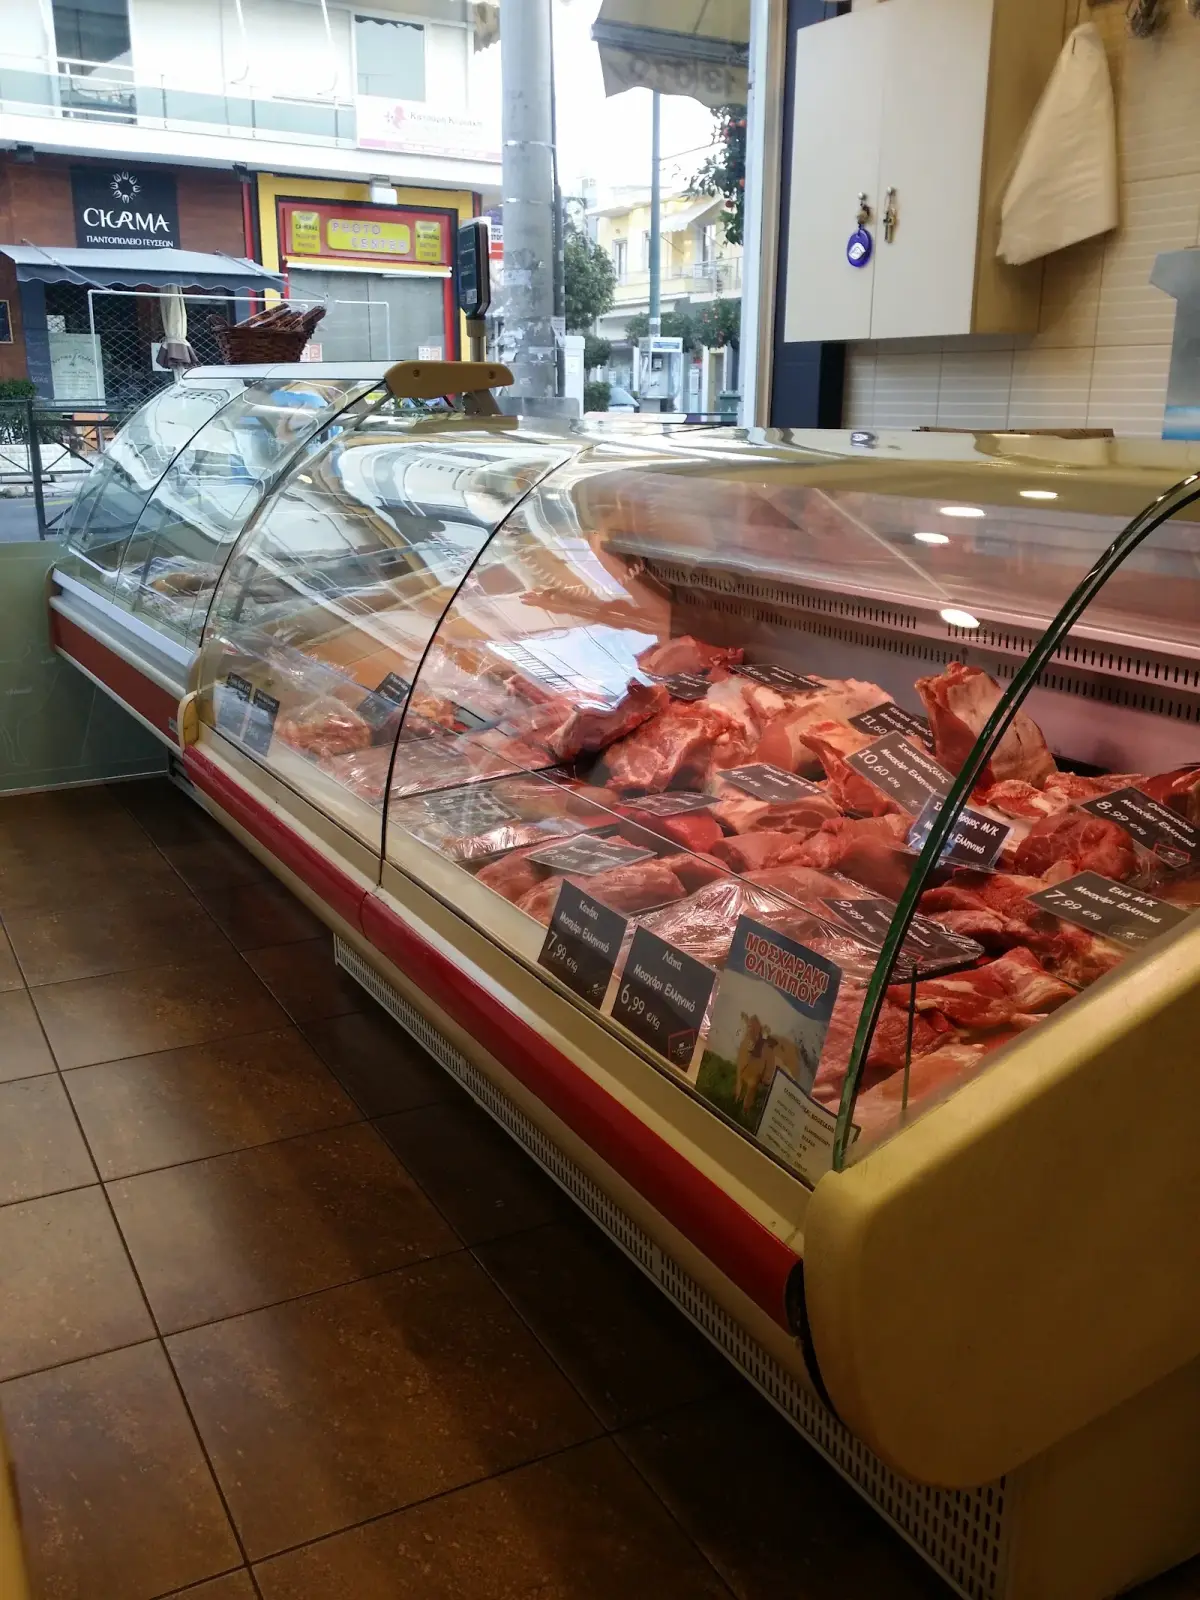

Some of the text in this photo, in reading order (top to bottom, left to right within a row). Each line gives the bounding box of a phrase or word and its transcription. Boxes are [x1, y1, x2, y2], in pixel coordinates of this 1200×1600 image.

[331, 222, 382, 235] PHOTO
[86, 235, 174, 248] ΠΑΝΤΟΠΩΛΕΙΟ ΓΕΥΣΕΩΝ
[351, 237, 408, 251] CENTER
[860, 715, 887, 734] 11,60
[858, 749, 889, 776] 10,60
[880, 748, 938, 795] Μοσχάρι Ελληνικό
[1096, 801, 1129, 822] 8,99
[1120, 799, 1197, 848] Μοσχάρι Ελληνικό
[954, 833, 985, 855] Ελληνικό
[1044, 889, 1082, 910] 7,99
[1074, 885, 1161, 924] Μοσχάρι Ελληνικό
[1108, 886, 1132, 899] Ελιά
[834, 900, 865, 921] 9,99
[559, 910, 610, 954] Μοσχάρι Ελληνικό
[547, 931, 567, 961] 7,99
[662, 950, 683, 972] Λάπα
[744, 931, 830, 994] ΜΟΣΧΑΡΑΚΙ
[633, 963, 663, 991] Μοσχάρι
[664, 982, 696, 1013] Ελληνικό
[744, 952, 822, 1008] ΟΛΥΜΠΟΥ
[621, 983, 646, 1015] 6,99
